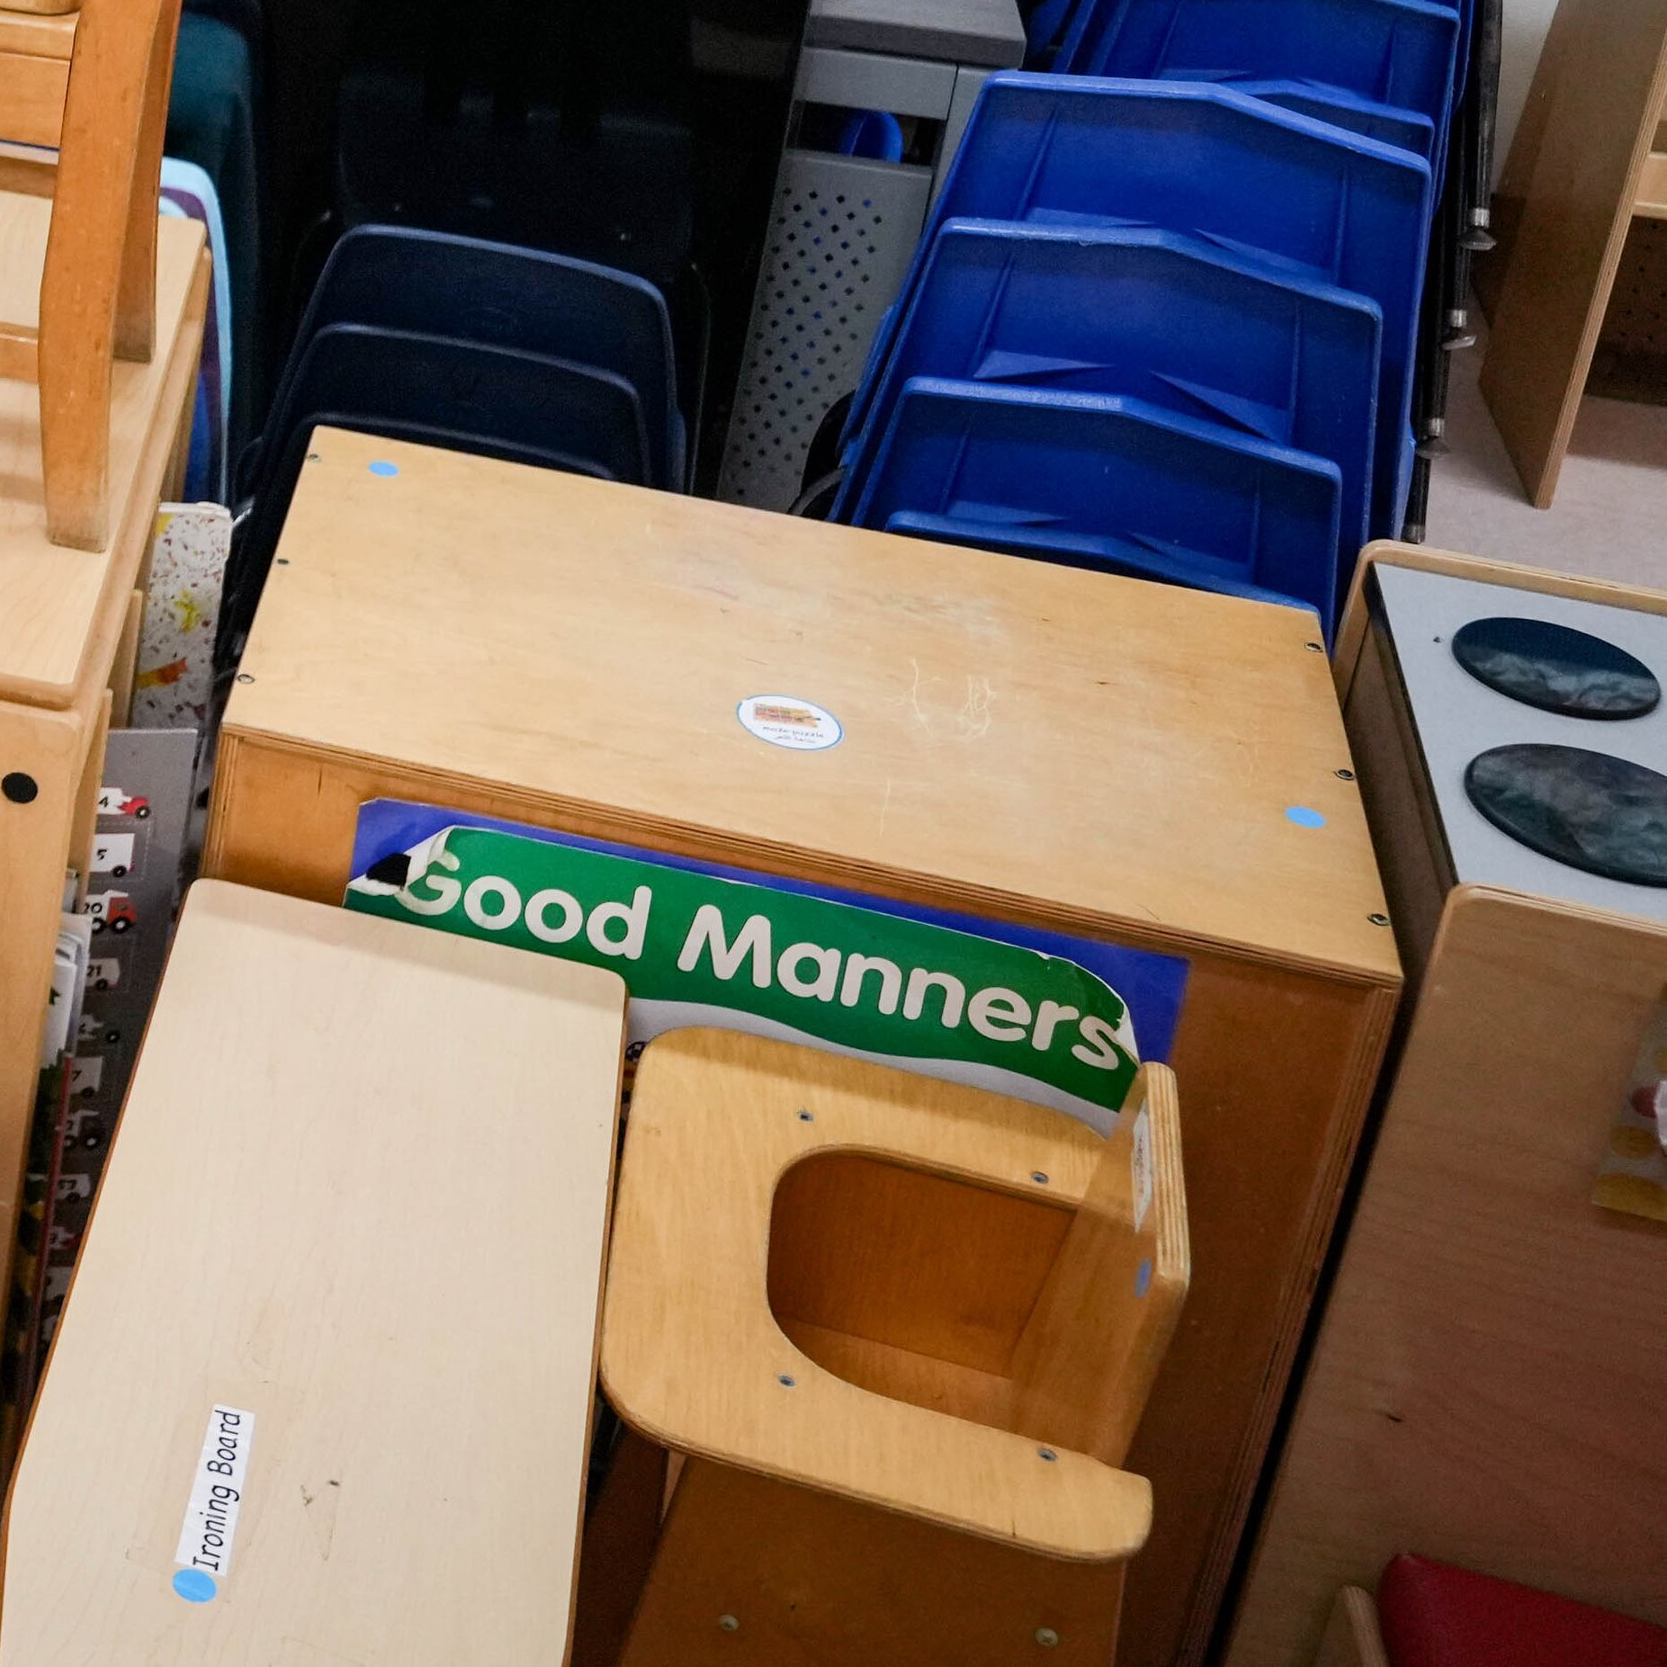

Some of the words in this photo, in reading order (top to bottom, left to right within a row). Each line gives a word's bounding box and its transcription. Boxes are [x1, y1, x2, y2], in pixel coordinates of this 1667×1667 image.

[97, 849, 108, 861] 5
[393, 849, 651, 961] Good
[676, 903, 1123, 1071] Manners
[207, 1409, 242, 1477] Board
[192, 1485, 241, 1572] Ironing
